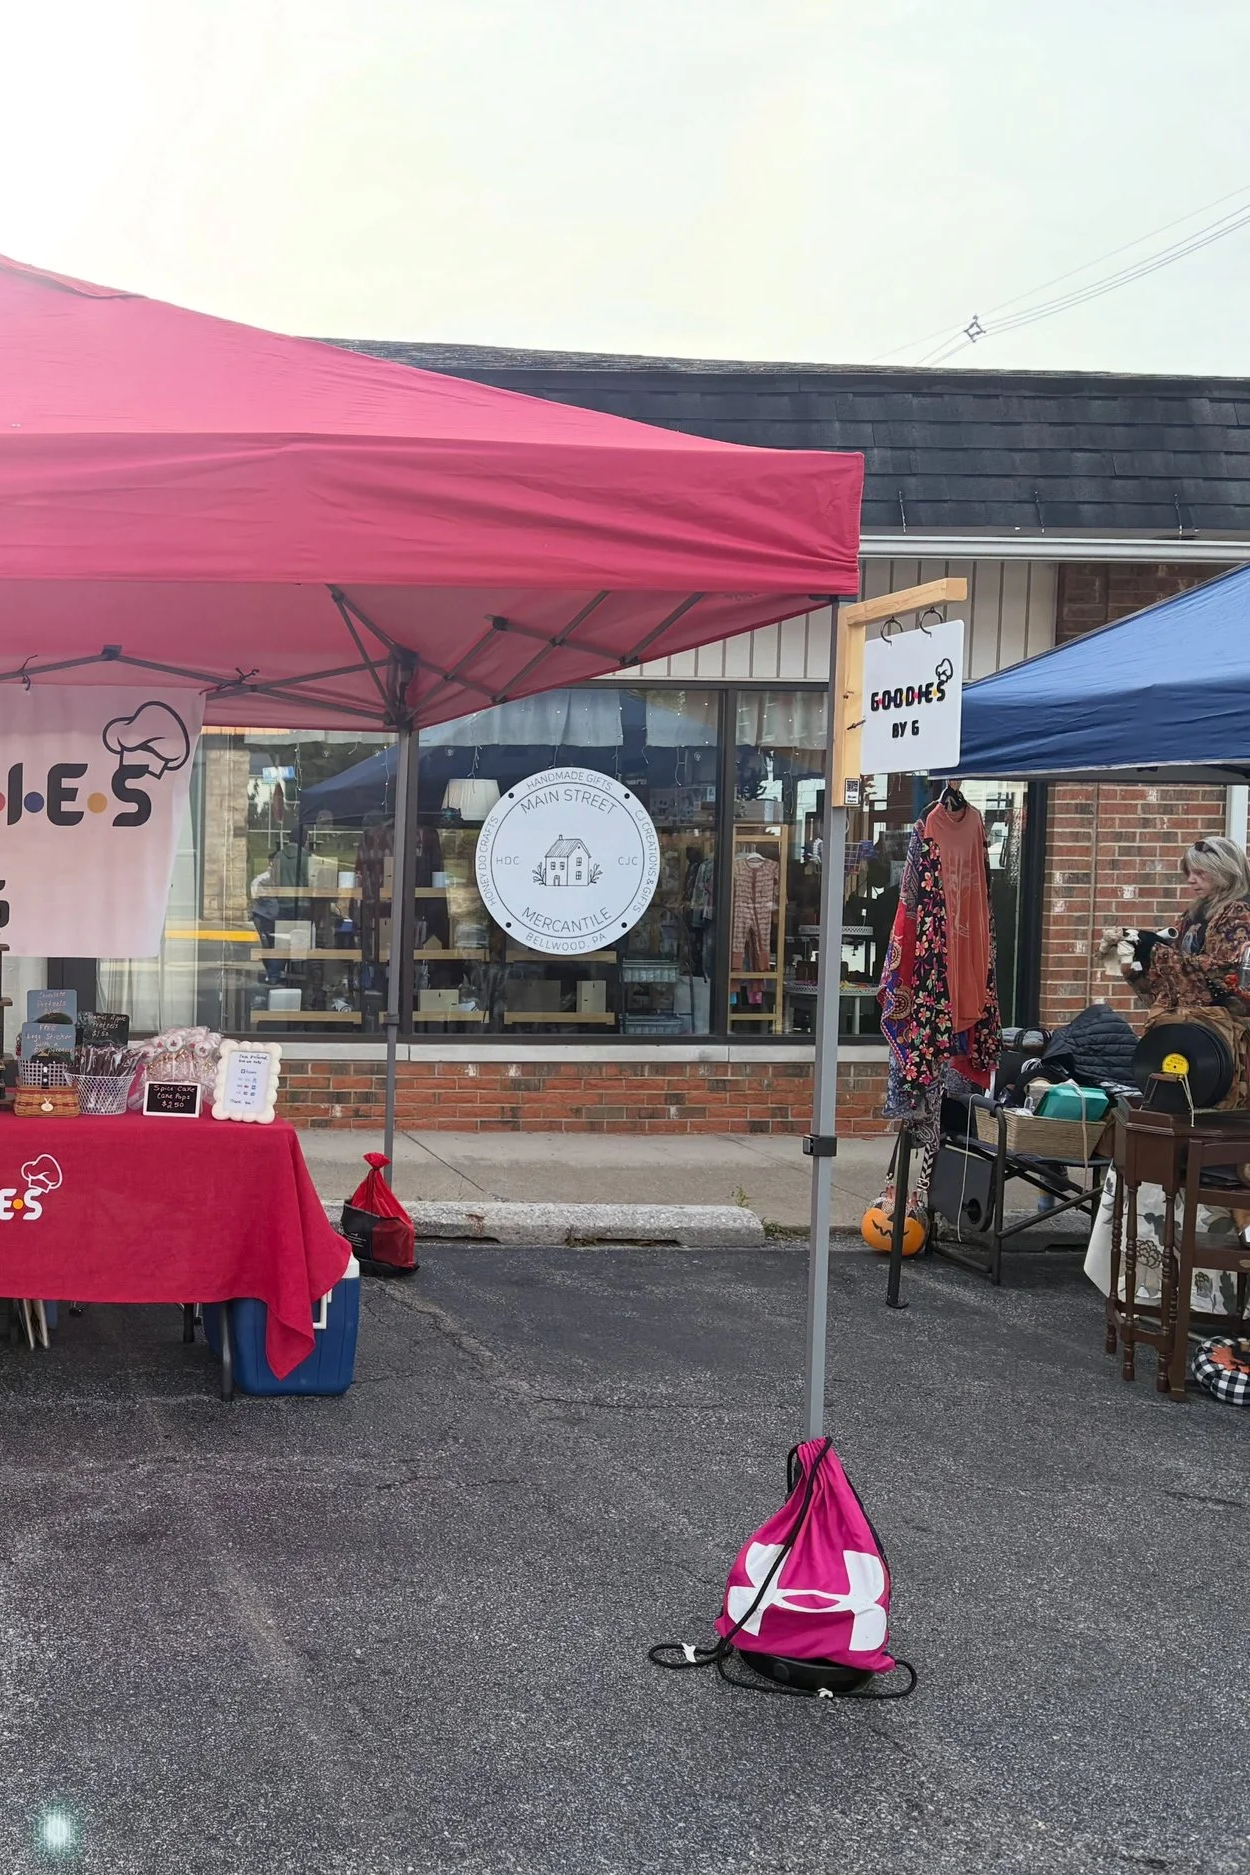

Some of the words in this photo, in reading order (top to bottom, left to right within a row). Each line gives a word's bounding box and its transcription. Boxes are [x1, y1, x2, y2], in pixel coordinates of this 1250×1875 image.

[870, 679, 946, 712] GOODIES
[892, 721, 908, 739] BY
[911, 720, 920, 736] G
[526, 770, 584, 790] HANDMADE
[586, 773, 613, 791] GIFTS
[520, 790, 560, 814] MAIN
[563, 789, 617, 815] STREET
[634, 809, 646, 822] CJ
[479, 816, 499, 851] CRAFTS
[478, 853, 487, 869] DO
[496, 856, 520, 865] HDC
[617, 856, 638, 866] CJC
[640, 820, 657, 881] CREATIONS
[478, 872, 497, 906] HONEY
[646, 879, 654, 887] &
[633, 887, 651, 914] GIFTS
[521, 906, 612, 933] MERCANTILE
[592, 933, 607, 943] PA
